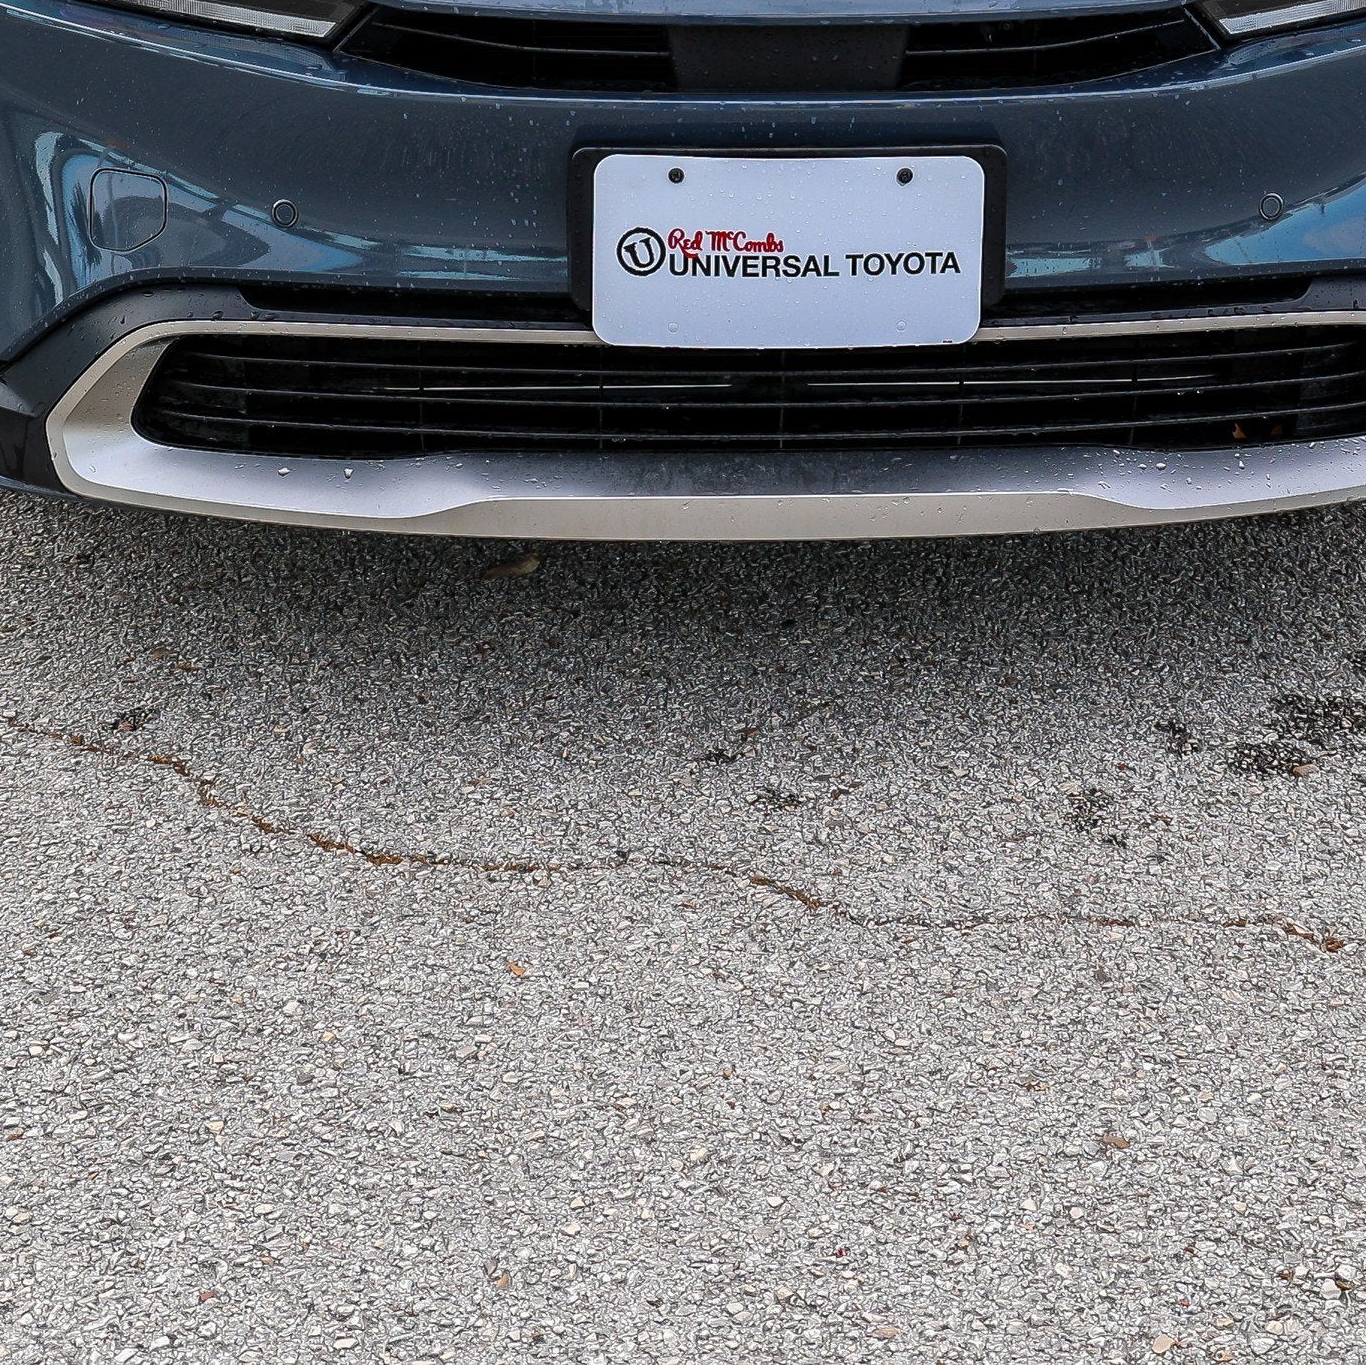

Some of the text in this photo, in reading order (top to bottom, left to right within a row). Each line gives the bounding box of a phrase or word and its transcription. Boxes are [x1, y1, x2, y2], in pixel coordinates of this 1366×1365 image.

[668, 228, 784, 257] Red McCombs
[669, 252, 961, 278] UNIVERSAL TOYOTA
